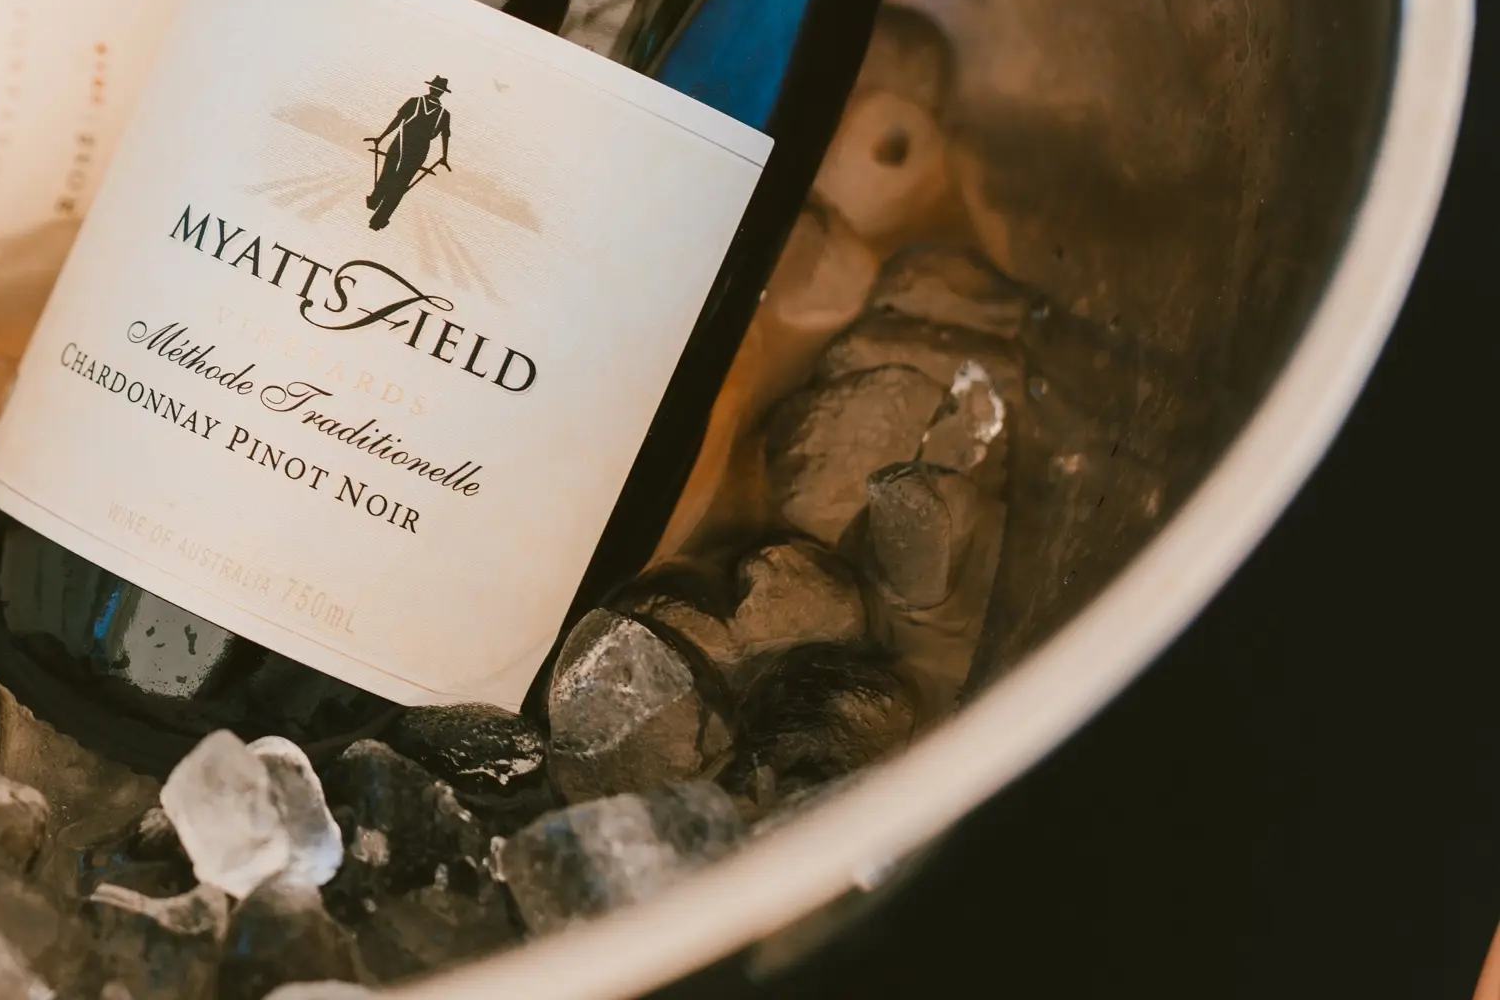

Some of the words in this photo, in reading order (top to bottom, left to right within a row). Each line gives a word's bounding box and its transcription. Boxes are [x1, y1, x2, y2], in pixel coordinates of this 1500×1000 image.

[59, 340, 222, 441] CHARDONNAY
[227, 426, 333, 491] PINOT
[335, 474, 423, 535] NOIR
[126, 320, 255, 397] Méthode
[259, 380, 484, 498] Traditionelle
[216, 304, 428, 418] VINEYARDS
[106, 501, 149, 540] WINE
[149, 521, 176, 550] OF
[176, 535, 274, 597] AUSTRALIA
[277, 576, 358, 637] 750mL
